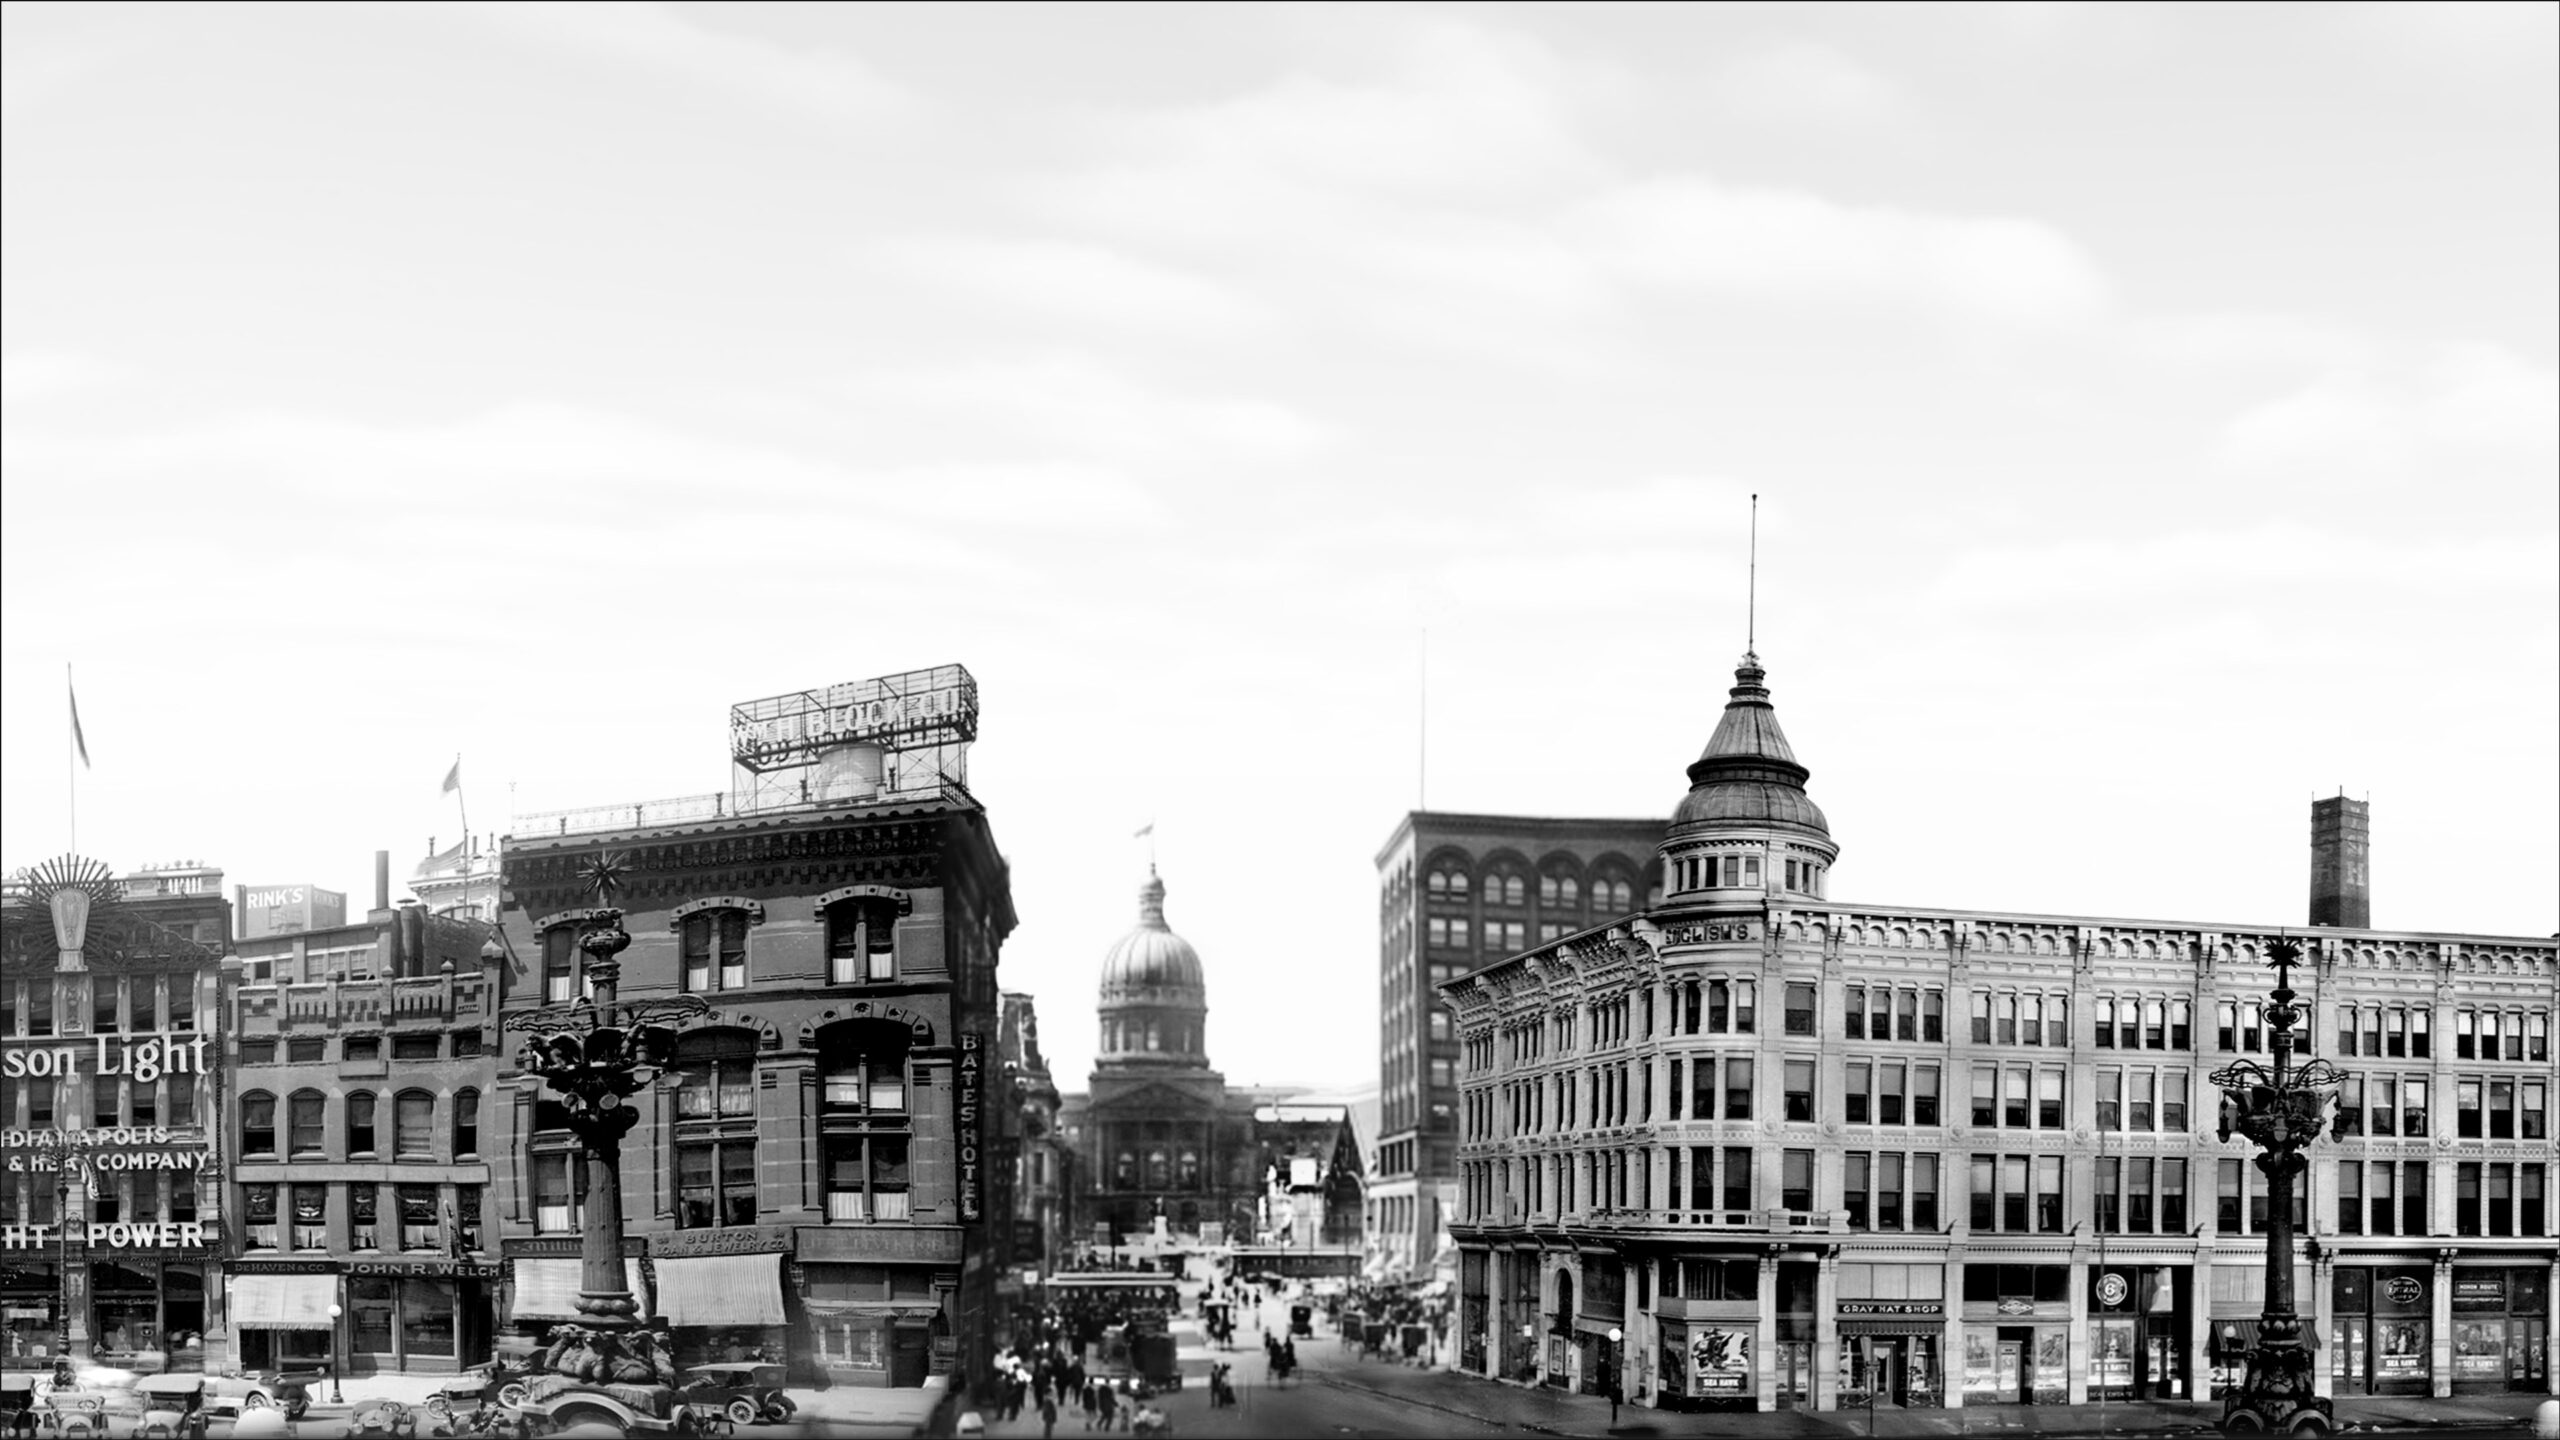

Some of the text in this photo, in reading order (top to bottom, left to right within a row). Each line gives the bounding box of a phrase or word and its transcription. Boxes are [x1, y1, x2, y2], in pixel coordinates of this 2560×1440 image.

[807, 697, 901, 737] BLOCK
[246, 887, 304, 909] RINK'S
[1665, 923, 1749, 945] ENGLISH'S
[2, 1034, 209, 1083] son Light
[960, 1034, 979, 1220] BATES HOTEL
[8, 1151, 209, 1172] & HEA COMPANY
[4, 1223, 204, 1249] HT POWER
[684, 1231, 758, 1245] BURTON
[656, 1246, 689, 1257] LOAN
[704, 1240, 767, 1253] JEWELRY
[342, 1262, 499, 1277] JOHN R. WELCH
[1843, 1304, 1939, 1314] GRAY HAT SHOP
